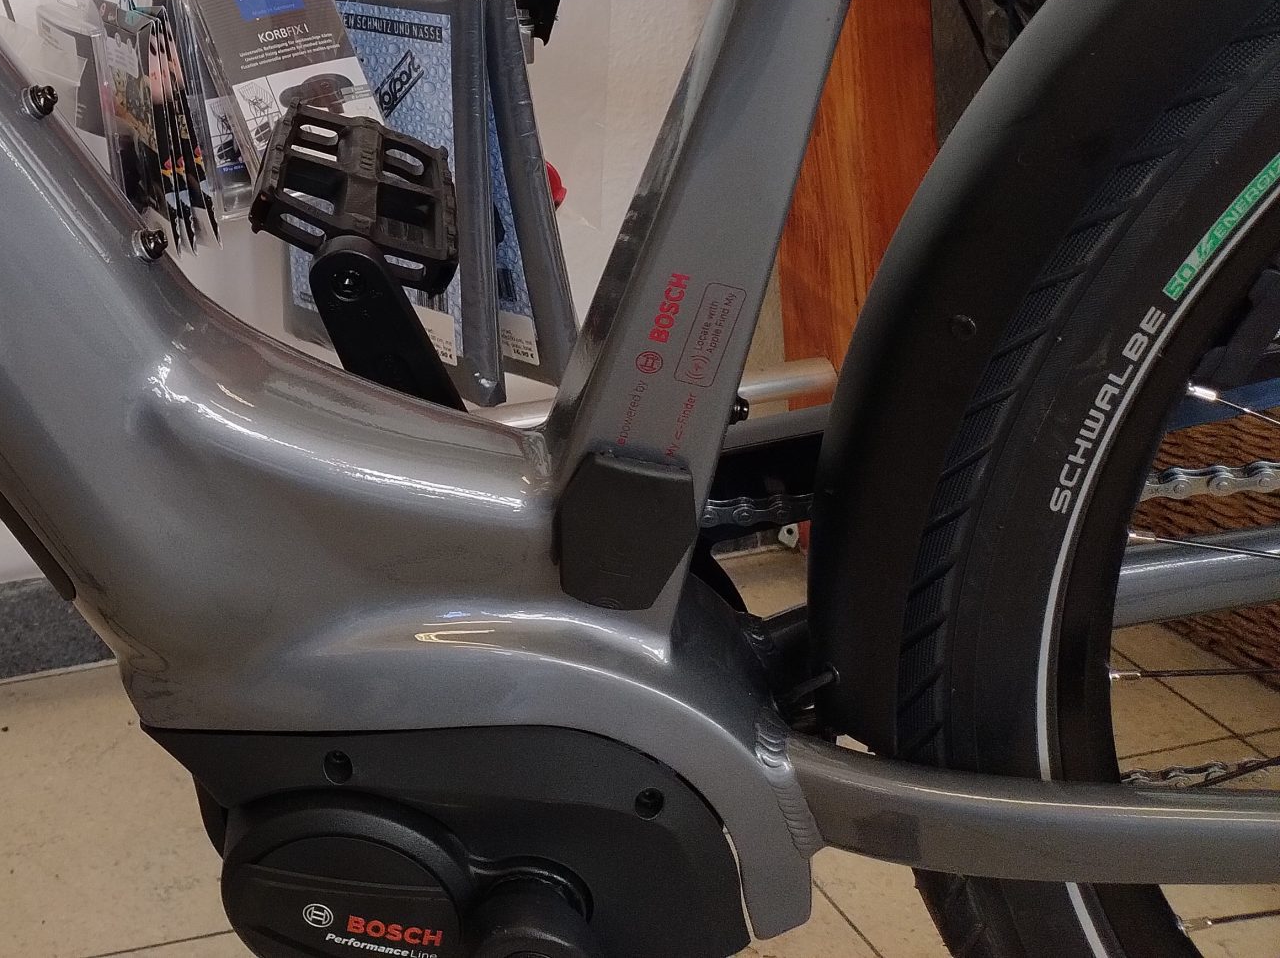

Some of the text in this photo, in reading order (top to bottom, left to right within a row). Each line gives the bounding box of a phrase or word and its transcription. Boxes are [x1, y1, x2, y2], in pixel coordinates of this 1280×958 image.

[257, 24, 301, 44] KORBFIX
[356, 15, 393, 33] SCHMUTZ
[394, 21, 410, 35] UND
[412, 22, 441, 41] NÄSSE
[648, 272, 691, 343] BOSCH
[694, 319, 712, 352] Locate
[1049, 306, 1167, 514] SCHWALBE
[325, 932, 410, 958] Performance
[346, 914, 444, 947] BOSCH
